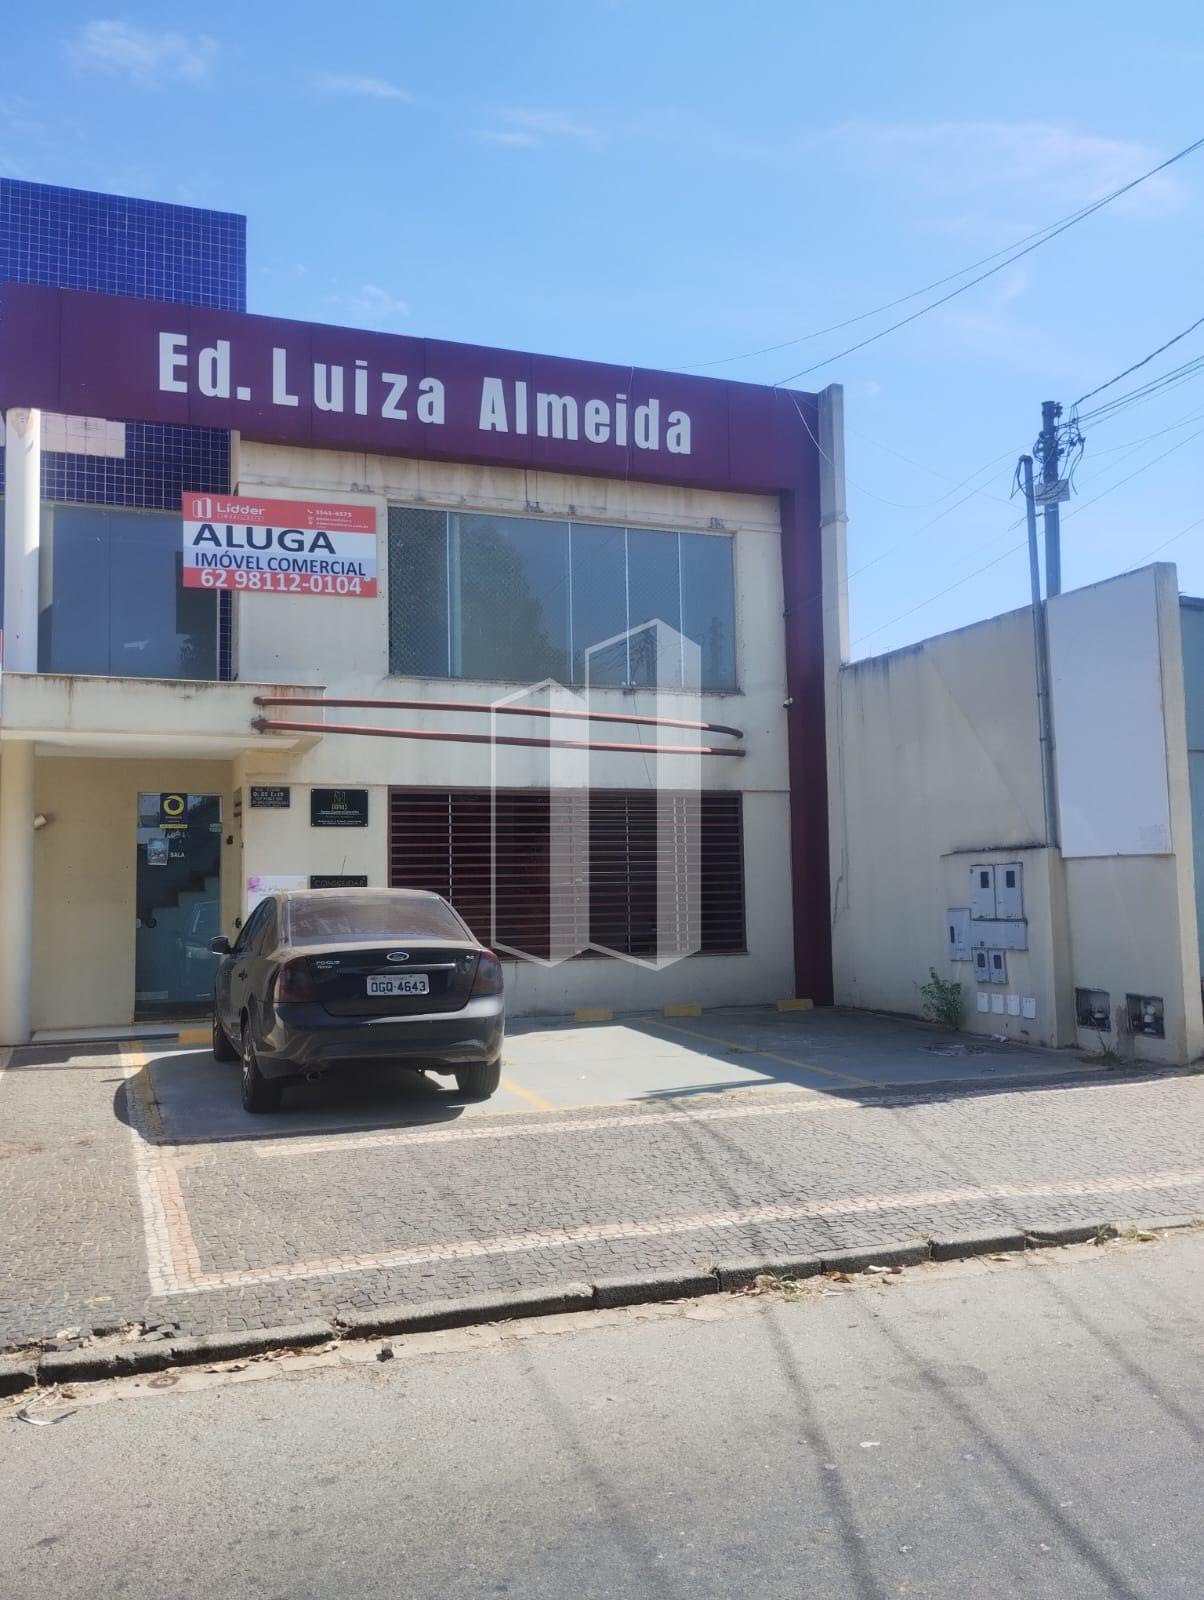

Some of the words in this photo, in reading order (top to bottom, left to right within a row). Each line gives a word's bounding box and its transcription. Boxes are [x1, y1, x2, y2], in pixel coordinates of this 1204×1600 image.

[159, 332, 251, 401] Ed.
[272, 347, 445, 425] Luiza
[479, 377, 692, 455] Almeida
[192, 523, 336, 555] ALUGA
[195, 551, 265, 571] IMÓVEL
[267, 557, 366, 577] COMERCIAL
[201, 569, 227, 588] 62
[235, 571, 362, 595] 98112-0104
